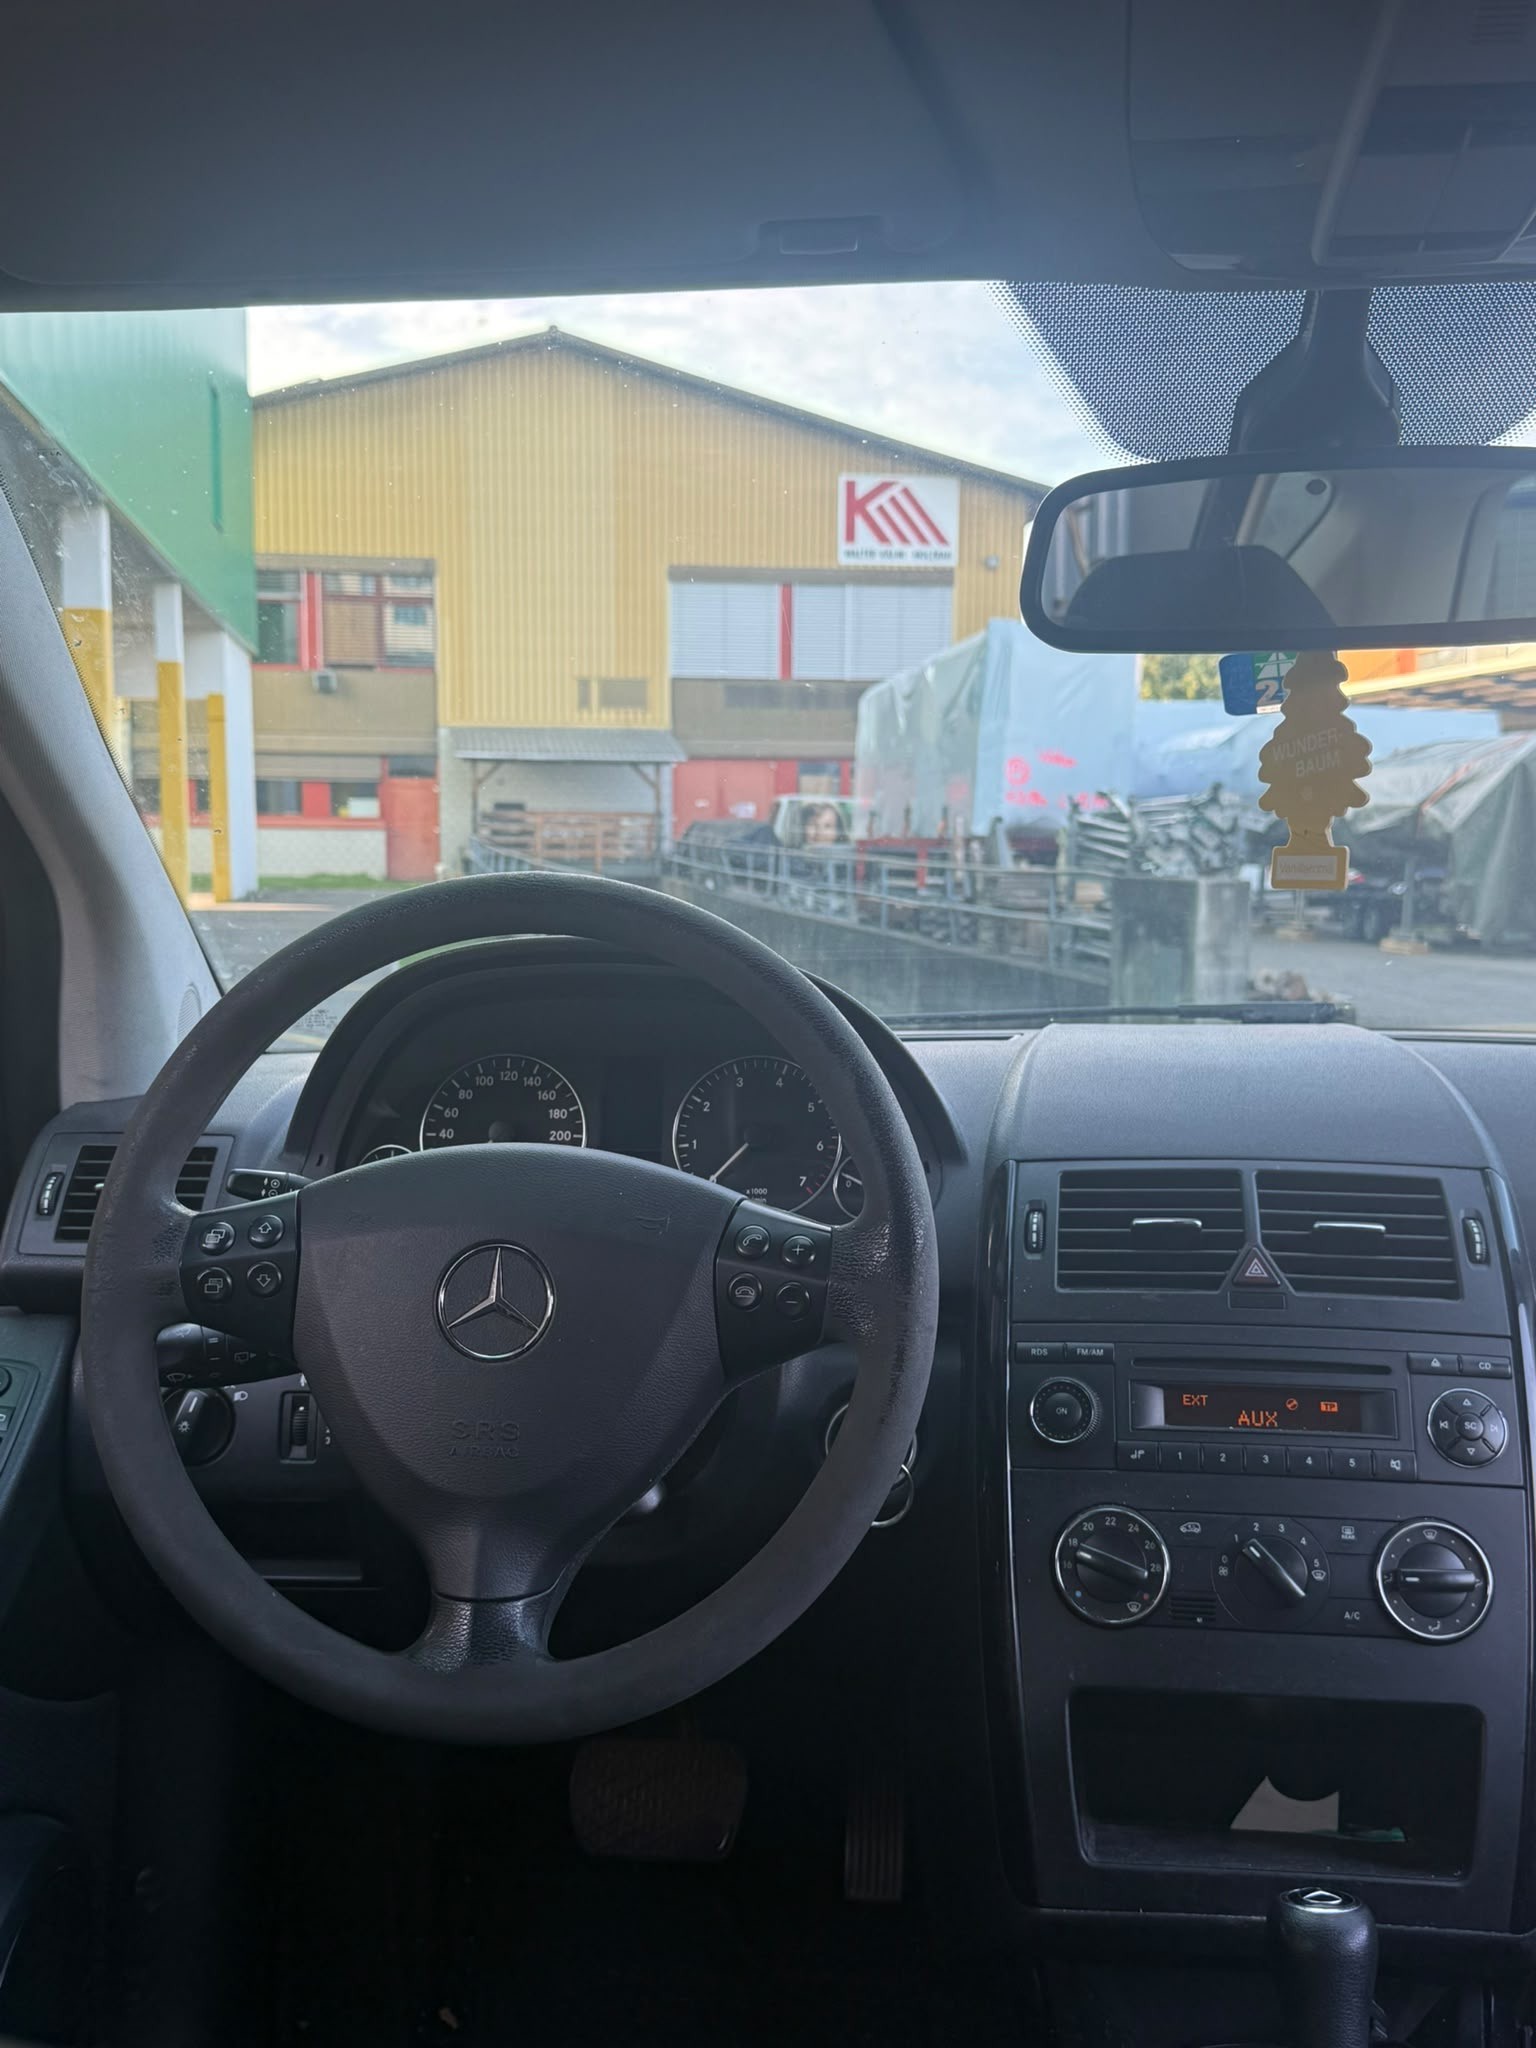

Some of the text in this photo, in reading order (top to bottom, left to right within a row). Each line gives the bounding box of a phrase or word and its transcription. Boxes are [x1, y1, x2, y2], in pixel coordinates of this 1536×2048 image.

[1271, 727, 1343, 761] WUNDER-
[1295, 750, 1341, 778] BAUM
[500, 1071, 518, 1081] 120
[475, 1076, 494, 1087] 100
[523, 1076, 542, 1087] 140
[736, 1077, 744, 1087] 3
[776, 1077, 784, 1087] 4
[459, 1089, 473, 1100] 80
[538, 1090, 557, 1101] 160
[703, 1102, 710, 1112] 2
[808, 1102, 815, 1113] 5
[444, 1107, 459, 1118] 60
[548, 1108, 568, 1119] 180
[439, 1128, 454, 1139] 40
[549, 1131, 571, 1141] 200
[691, 1139, 697, 1149] 1
[817, 1141, 824, 1151] 6
[800, 1176, 807, 1187] 7
[1031, 1348, 1048, 1356] RDS
[1076, 1348, 1104, 1356] FM/AM
[1478, 1362, 1492, 1370] CD
[1182, 1394, 1208, 1406] EXT
[1056, 1407, 1068, 1415] ON
[1238, 1410, 1278, 1427] AUX
[1464, 1421, 1477, 1430] SC
[453, 1421, 520, 1441] SRS
[1219, 1453, 1226, 1462] 2
[1262, 1454, 1270, 1464] 3
[1305, 1456, 1313, 1465] 4
[1349, 1458, 1356, 1468] 5
[1082, 1522, 1094, 1531] 20
[1105, 1517, 1117, 1526] 22
[1128, 1524, 1139, 1533] 24
[1253, 1522, 1259, 1532] 2
[1278, 1524, 1285, 1533] 3
[1068, 1538, 1078, 1547] 18
[1144, 1540, 1156, 1550] 26
[1300, 1537, 1307, 1545] 4
[1063, 1560, 1072, 1569] 16
[1150, 1563, 1162, 1573] 28
[1314, 1559, 1320, 1568] 5
[1344, 1611, 1361, 1620] A/C
